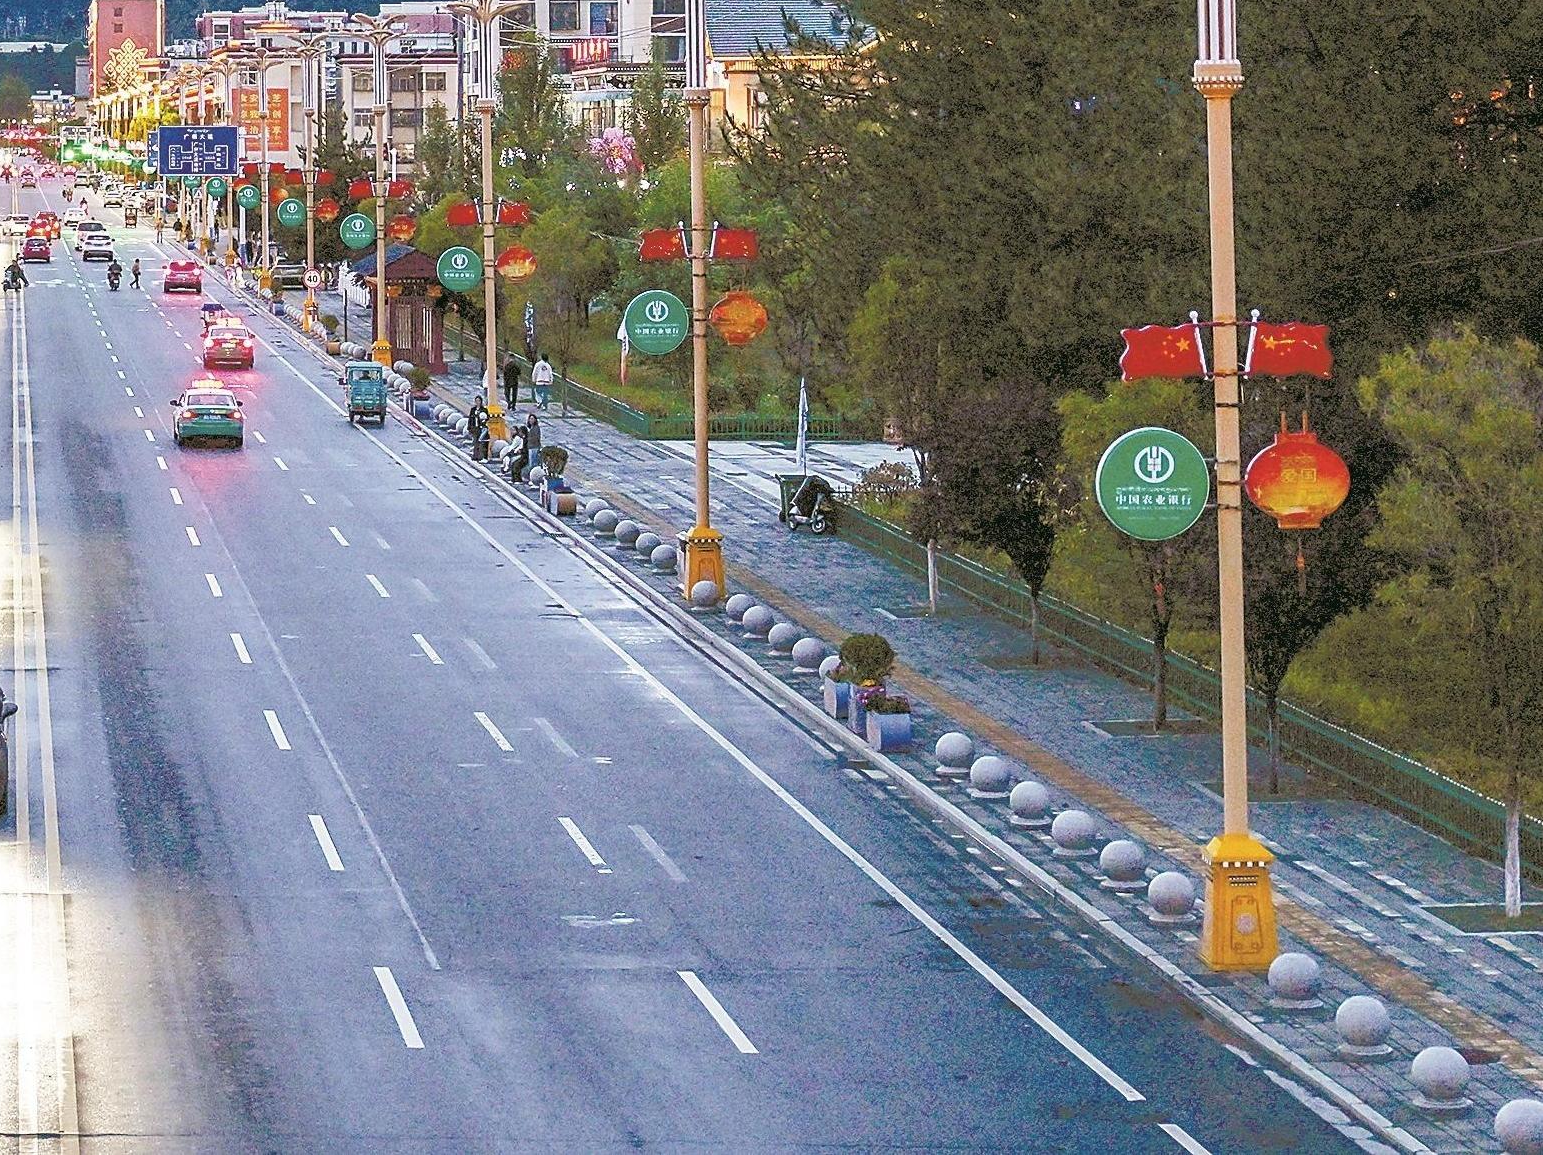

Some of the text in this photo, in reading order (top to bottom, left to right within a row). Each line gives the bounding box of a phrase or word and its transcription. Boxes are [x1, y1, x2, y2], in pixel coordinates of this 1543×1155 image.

[307, 275, 318, 283] 40
[1280, 468, 1317, 483] 爱国
[1115, 494, 1192, 506] 中国农业银行
